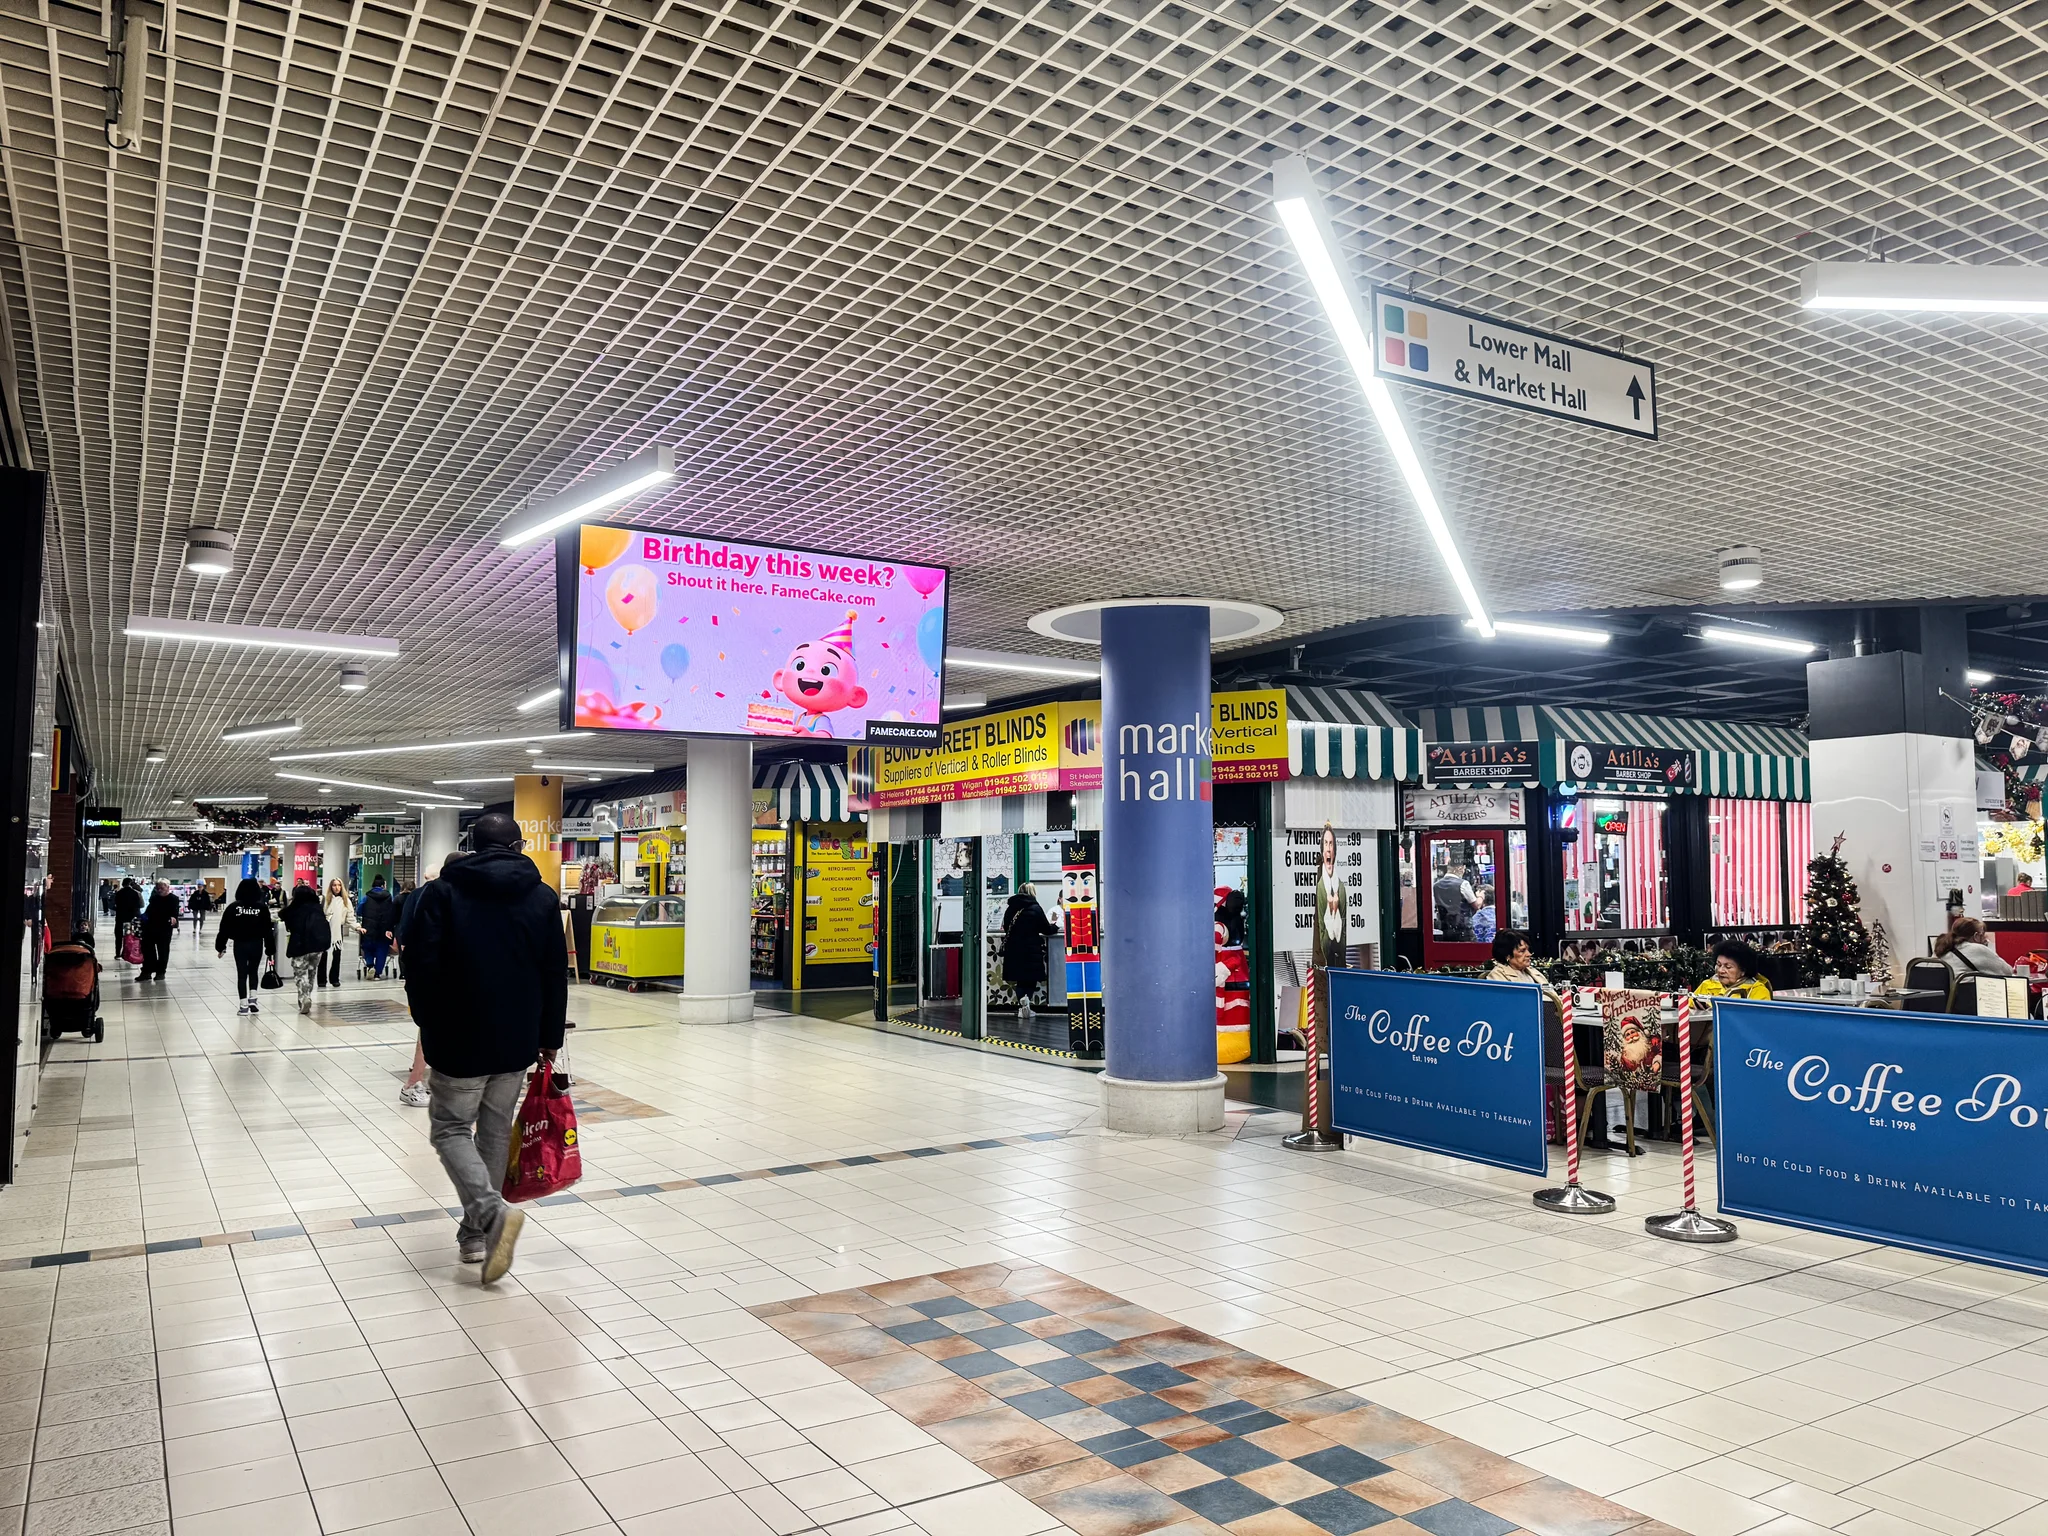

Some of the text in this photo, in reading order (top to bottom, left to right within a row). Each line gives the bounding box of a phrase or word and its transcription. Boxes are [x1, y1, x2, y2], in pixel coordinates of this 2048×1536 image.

[1468, 324, 1571, 372] Lower Mall
[1454, 358, 1587, 411] & Market Hall
[643, 537, 895, 587] Birthday this week?
[667, 571, 876, 606] Shout it here. FameCake.com
[1219, 701, 1278, 722] BLINDS
[870, 726, 937, 739] FAMECAKE.COM
[885, 746, 921, 764] BOND
[981, 713, 1047, 747] BLINDS
[1212, 724, 1277, 739] Vertical
[1211, 742, 1255, 755] linds
[1439, 746, 1527, 765] Atilla's
[884, 745, 1047, 786] Suppliers of Vertical & Roller Blinds
[1607, 749, 1660, 768] Atilla's
[1218, 772, 1244, 780] 01942
[1246, 771, 1261, 779] 502
[1263, 770, 1279, 778] 015
[1239, 764, 1257, 772] 502
[1260, 763, 1278, 771] 015
[1453, 767, 1513, 776] BARBER SHOP
[1616, 770, 1637, 778] BARBER
[961, 772, 1048, 790] Wigan 01942 502 015
[1119, 757, 1195, 801] hall
[905, 788, 925, 796] 01744
[927, 785, 940, 793] 644
[961, 781, 1049, 798] Manchester 01942 502 015
[910, 795, 929, 804] 01695
[943, 792, 955, 800] 113
[1429, 793, 1497, 809] ATILLA'S
[86, 819, 119, 827] GymWorks
[1437, 810, 1487, 821] BARBERS
[1605, 822, 1626, 832] OPEN
[525, 833, 547, 852] all
[810, 835, 854, 851] Sweet
[1286, 830, 1292, 846] 7
[1293, 830, 1321, 845] VERTIC
[1347, 832, 1361, 846] £99
[842, 845, 868, 860] Stall
[1285, 850, 1292, 867] 6
[1347, 852, 1362, 867] £99
[1294, 872, 1362, 887] VENET £69
[1295, 892, 1363, 907] RIGID £49
[236, 906, 260, 916] Juicy
[1295, 914, 1365, 928] SLAT 50p
[1602, 989, 1631, 1003] Merry
[1602, 994, 1661, 1019] Christmas
[1344, 1005, 1514, 1062] The Coffee Pot
[1412, 1054, 1438, 1065] Est. 1998
[1745, 1048, 1783, 1071] The
[1787, 1055, 1942, 1116] Coffee
[1869, 1117, 1917, 1131] Est. 1998
[1854, 1173, 1861, 1182] &
